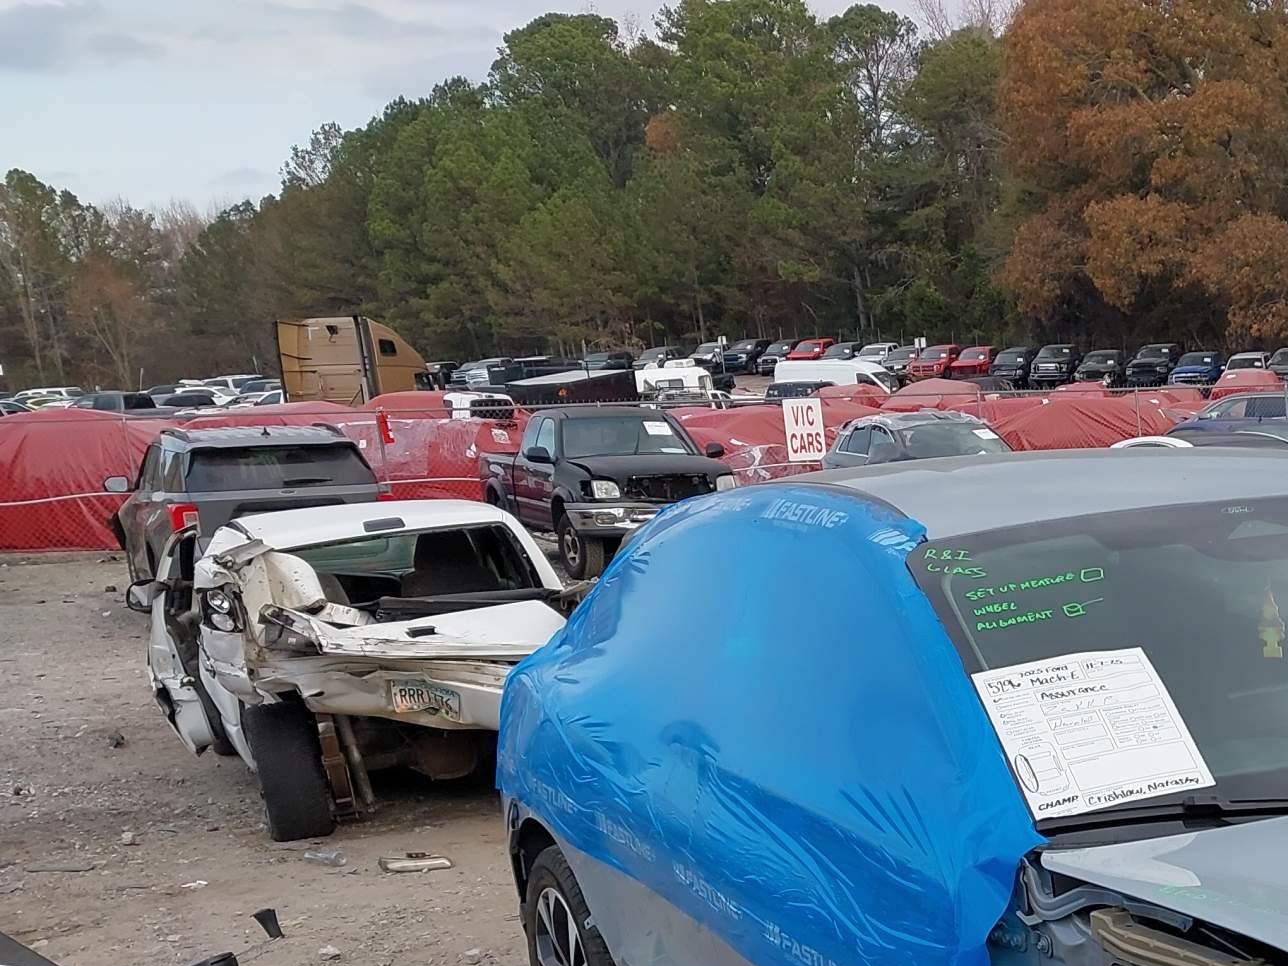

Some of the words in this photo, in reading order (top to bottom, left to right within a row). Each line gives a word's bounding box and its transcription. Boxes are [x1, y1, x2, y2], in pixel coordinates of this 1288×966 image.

[791, 405, 815, 427] VIC
[790, 432, 823, 453] CARS
[966, 589, 996, 601] SET
[1000, 583, 1017, 593] UP
[974, 602, 1017, 616] WHEEL
[1038, 795, 1079, 811] CHAMP
